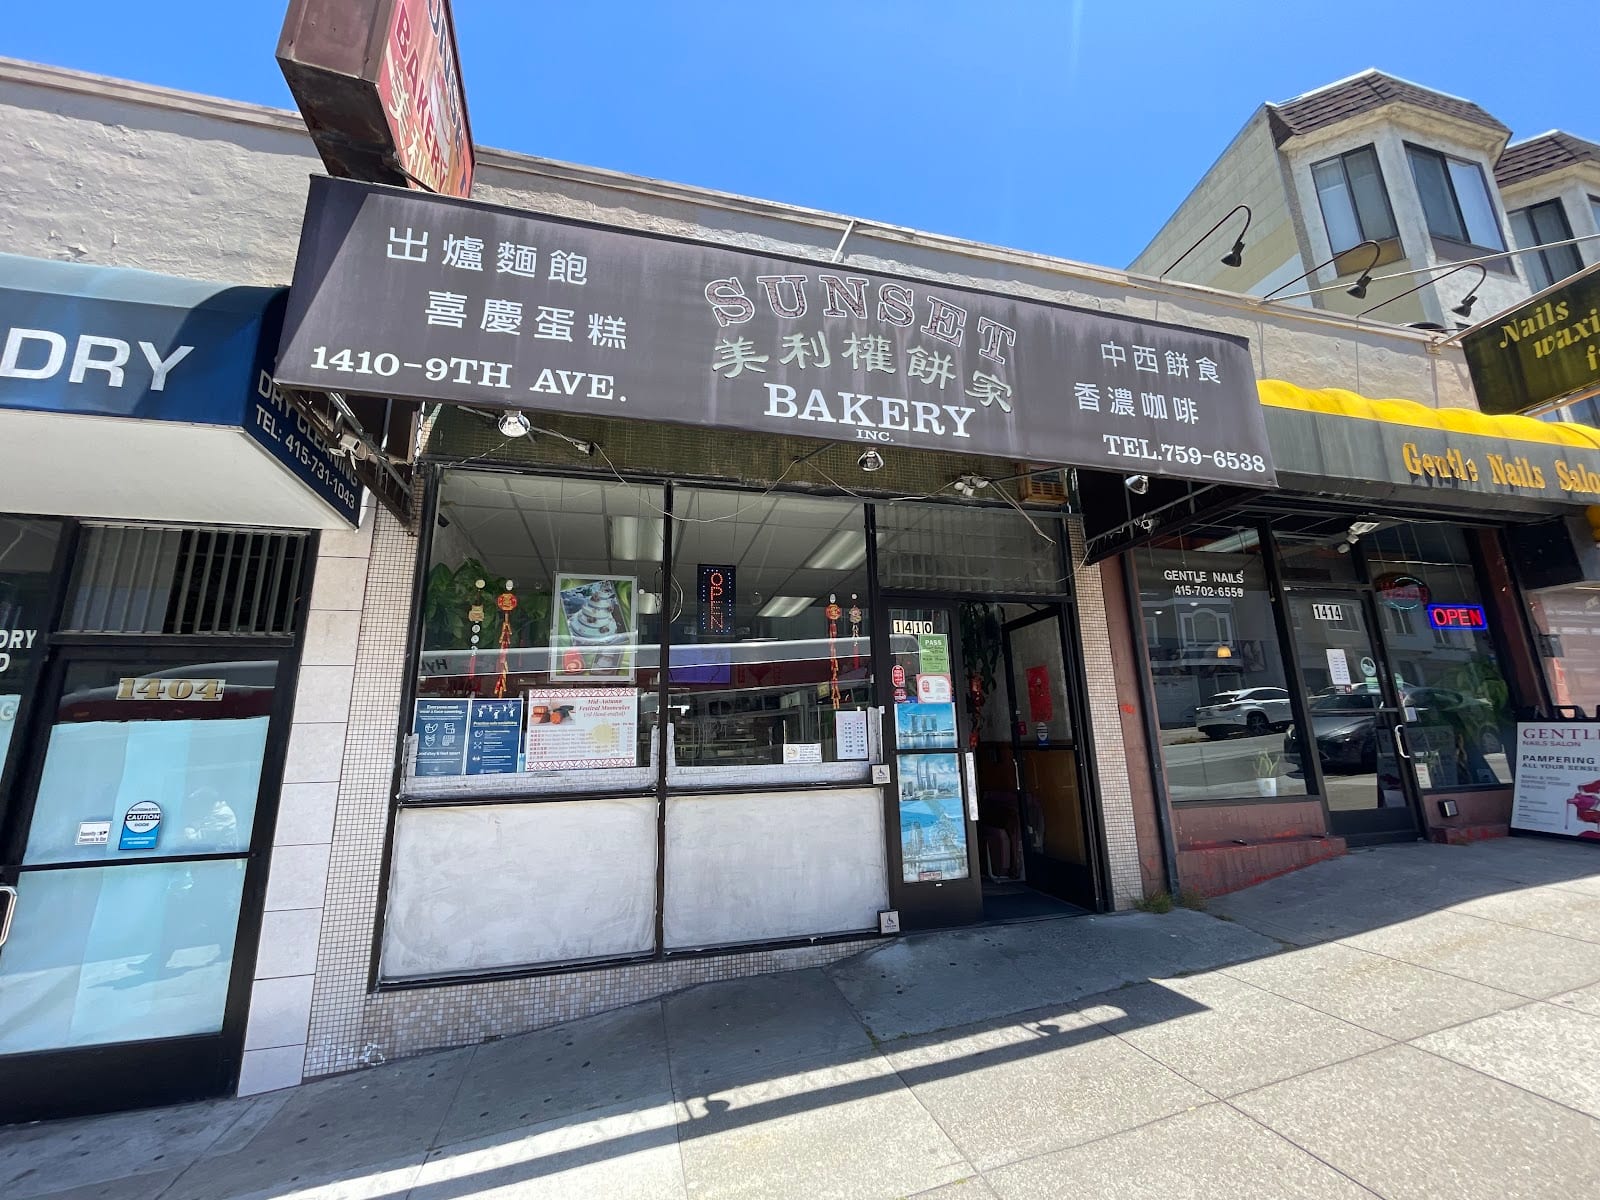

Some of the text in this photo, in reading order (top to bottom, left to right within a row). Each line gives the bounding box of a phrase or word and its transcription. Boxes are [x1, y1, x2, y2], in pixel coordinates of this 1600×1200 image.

[387, 227, 588, 285] 出爐麵飽
[424, 290, 627, 349] 喜慶蛋糕
[705, 274, 1016, 364] SUNSET
[1499, 301, 1569, 348] Nails
[0, 327, 195, 391] DRY
[310, 346, 627, 402] 1410-9TH AVE.
[711, 330, 1013, 413] 美利權餅家
[1100, 341, 1221, 384] 中西餅食
[763, 382, 976, 438] BAKERY
[1074, 382, 1199, 425] 香濃咖啡
[256, 404, 355, 510] TEL: 415-731-1043
[855, 428, 895, 443] INC.
[1402, 443, 1479, 482] Gentle
[1487, 453, 1546, 489] Nails
[1164, 569, 1244, 584] GENTLE NAILS
[710, 572, 723, 630] OPEN
[1314, 605, 1341, 619] 1414
[1432, 608, 1483, 626] OPEN
[894, 622, 932, 633] 1410
[118, 679, 223, 699] 1404
[1522, 754, 1595, 764] PAMPERING
